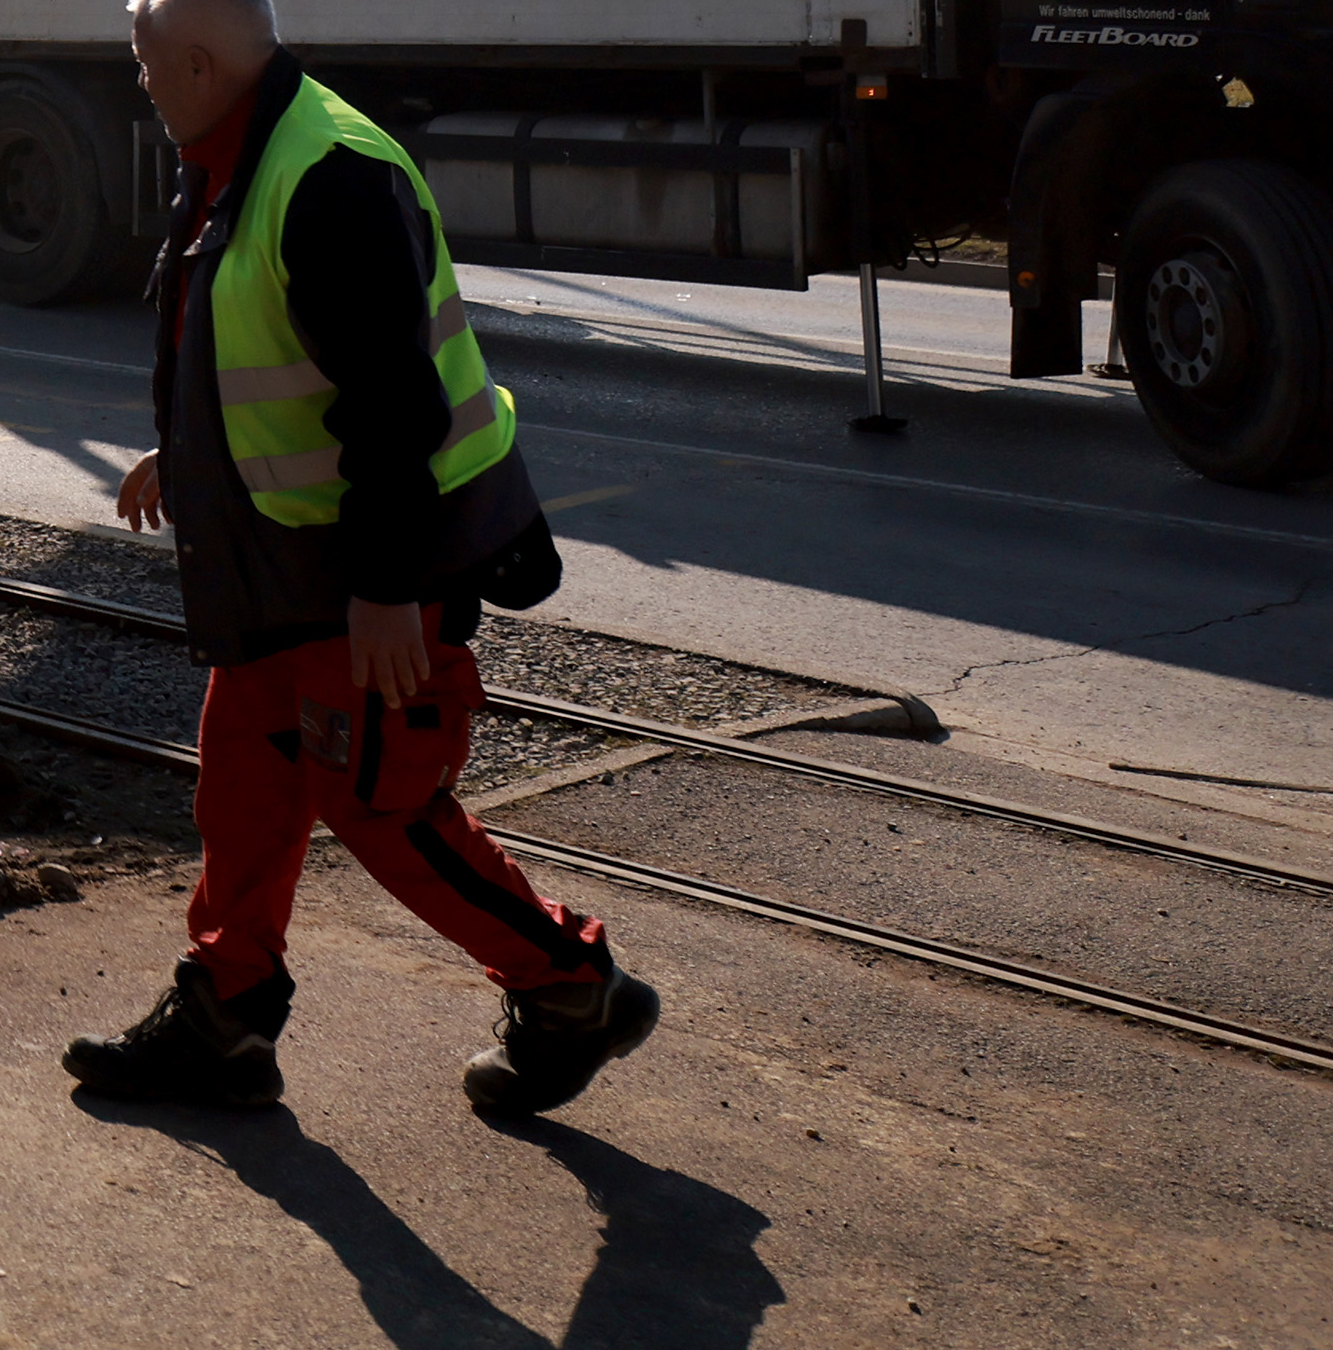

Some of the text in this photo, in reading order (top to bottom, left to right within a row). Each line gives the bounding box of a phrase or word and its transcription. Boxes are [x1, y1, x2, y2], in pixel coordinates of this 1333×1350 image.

[1039, 5, 1054, 17] Wir
[1058, 5, 1089, 18] fahren
[1091, 6, 1175, 21] umweltschonend
[1185, 8, 1211, 21] dank
